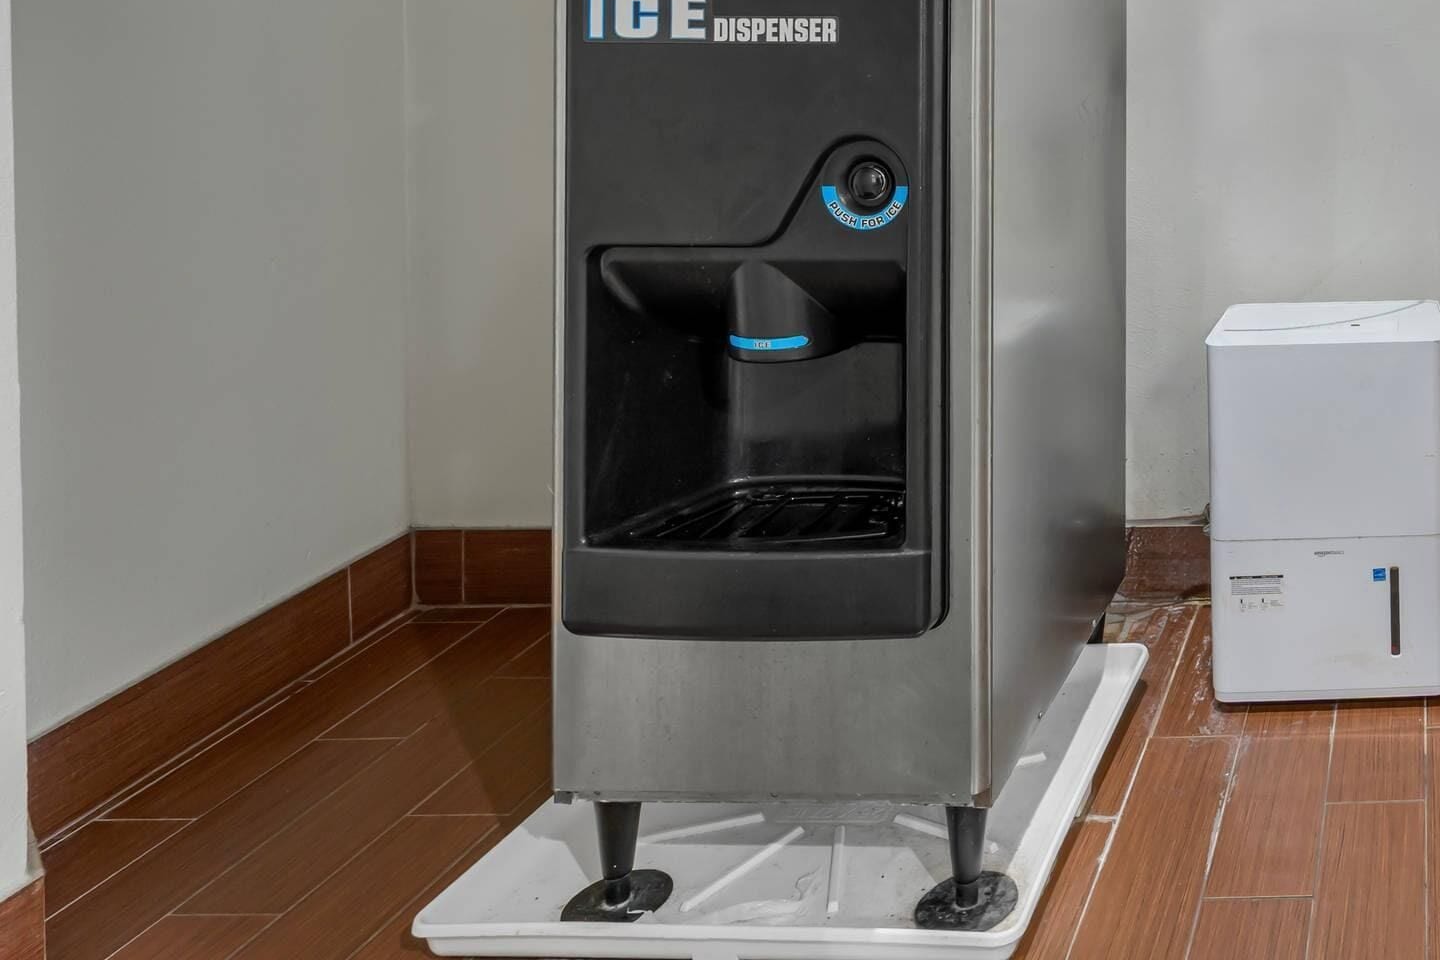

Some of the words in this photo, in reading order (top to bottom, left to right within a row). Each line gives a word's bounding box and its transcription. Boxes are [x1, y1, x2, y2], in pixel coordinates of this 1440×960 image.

[713, 17, 837, 43] DISPENSER
[829, 202, 858, 226] PUSH
[861, 216, 885, 228] FOR
[885, 201, 902, 219] ICE
